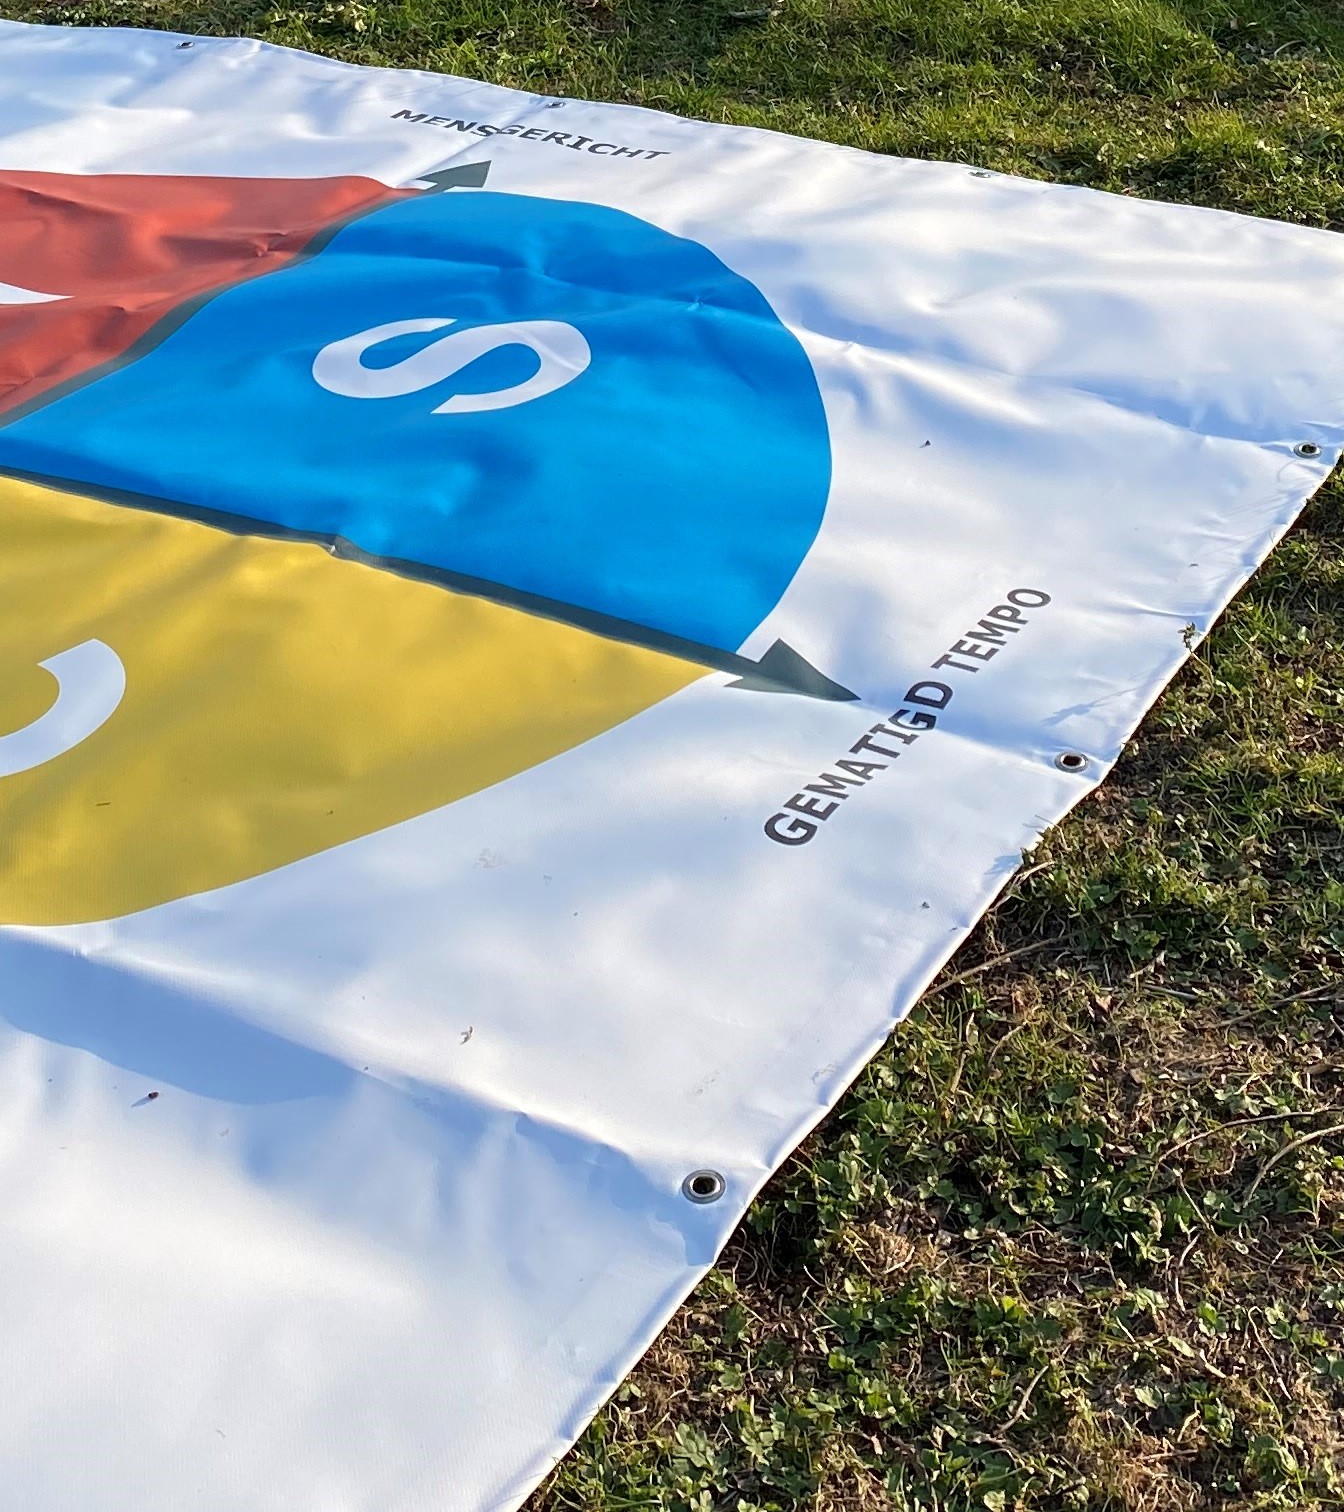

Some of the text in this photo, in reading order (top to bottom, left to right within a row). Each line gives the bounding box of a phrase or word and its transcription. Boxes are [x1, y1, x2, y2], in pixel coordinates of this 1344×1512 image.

[390, 108, 671, 161] MENSGERICHT
[312, 317, 592, 414] S
[763, 587, 1052, 847] GEMATIGD TEMPO
